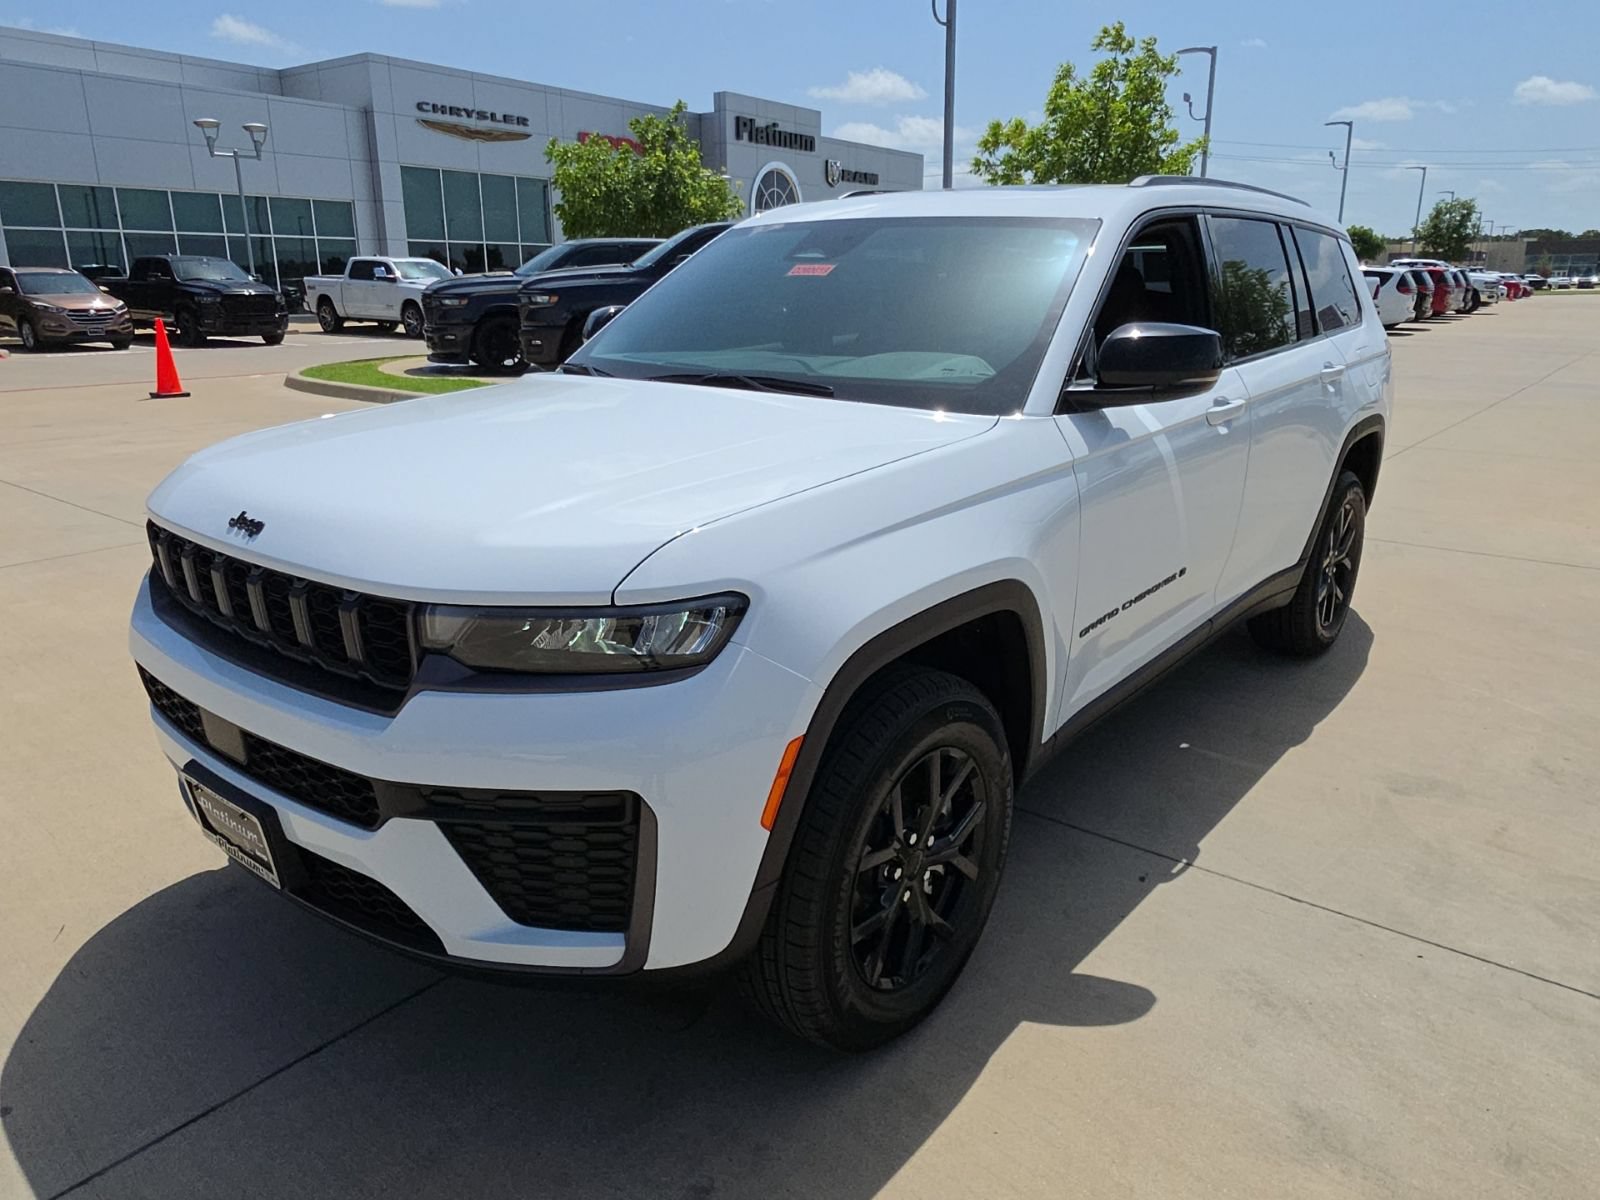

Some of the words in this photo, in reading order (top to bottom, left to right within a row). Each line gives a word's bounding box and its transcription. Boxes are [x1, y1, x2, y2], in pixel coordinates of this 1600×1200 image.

[416, 101, 530, 127] CHRYSLER
[735, 116, 816, 152] Platinum
[841, 168, 879, 186] RAM
[1079, 607, 1120, 638] GRAND
[1121, 572, 1178, 611] CHEROKEE
